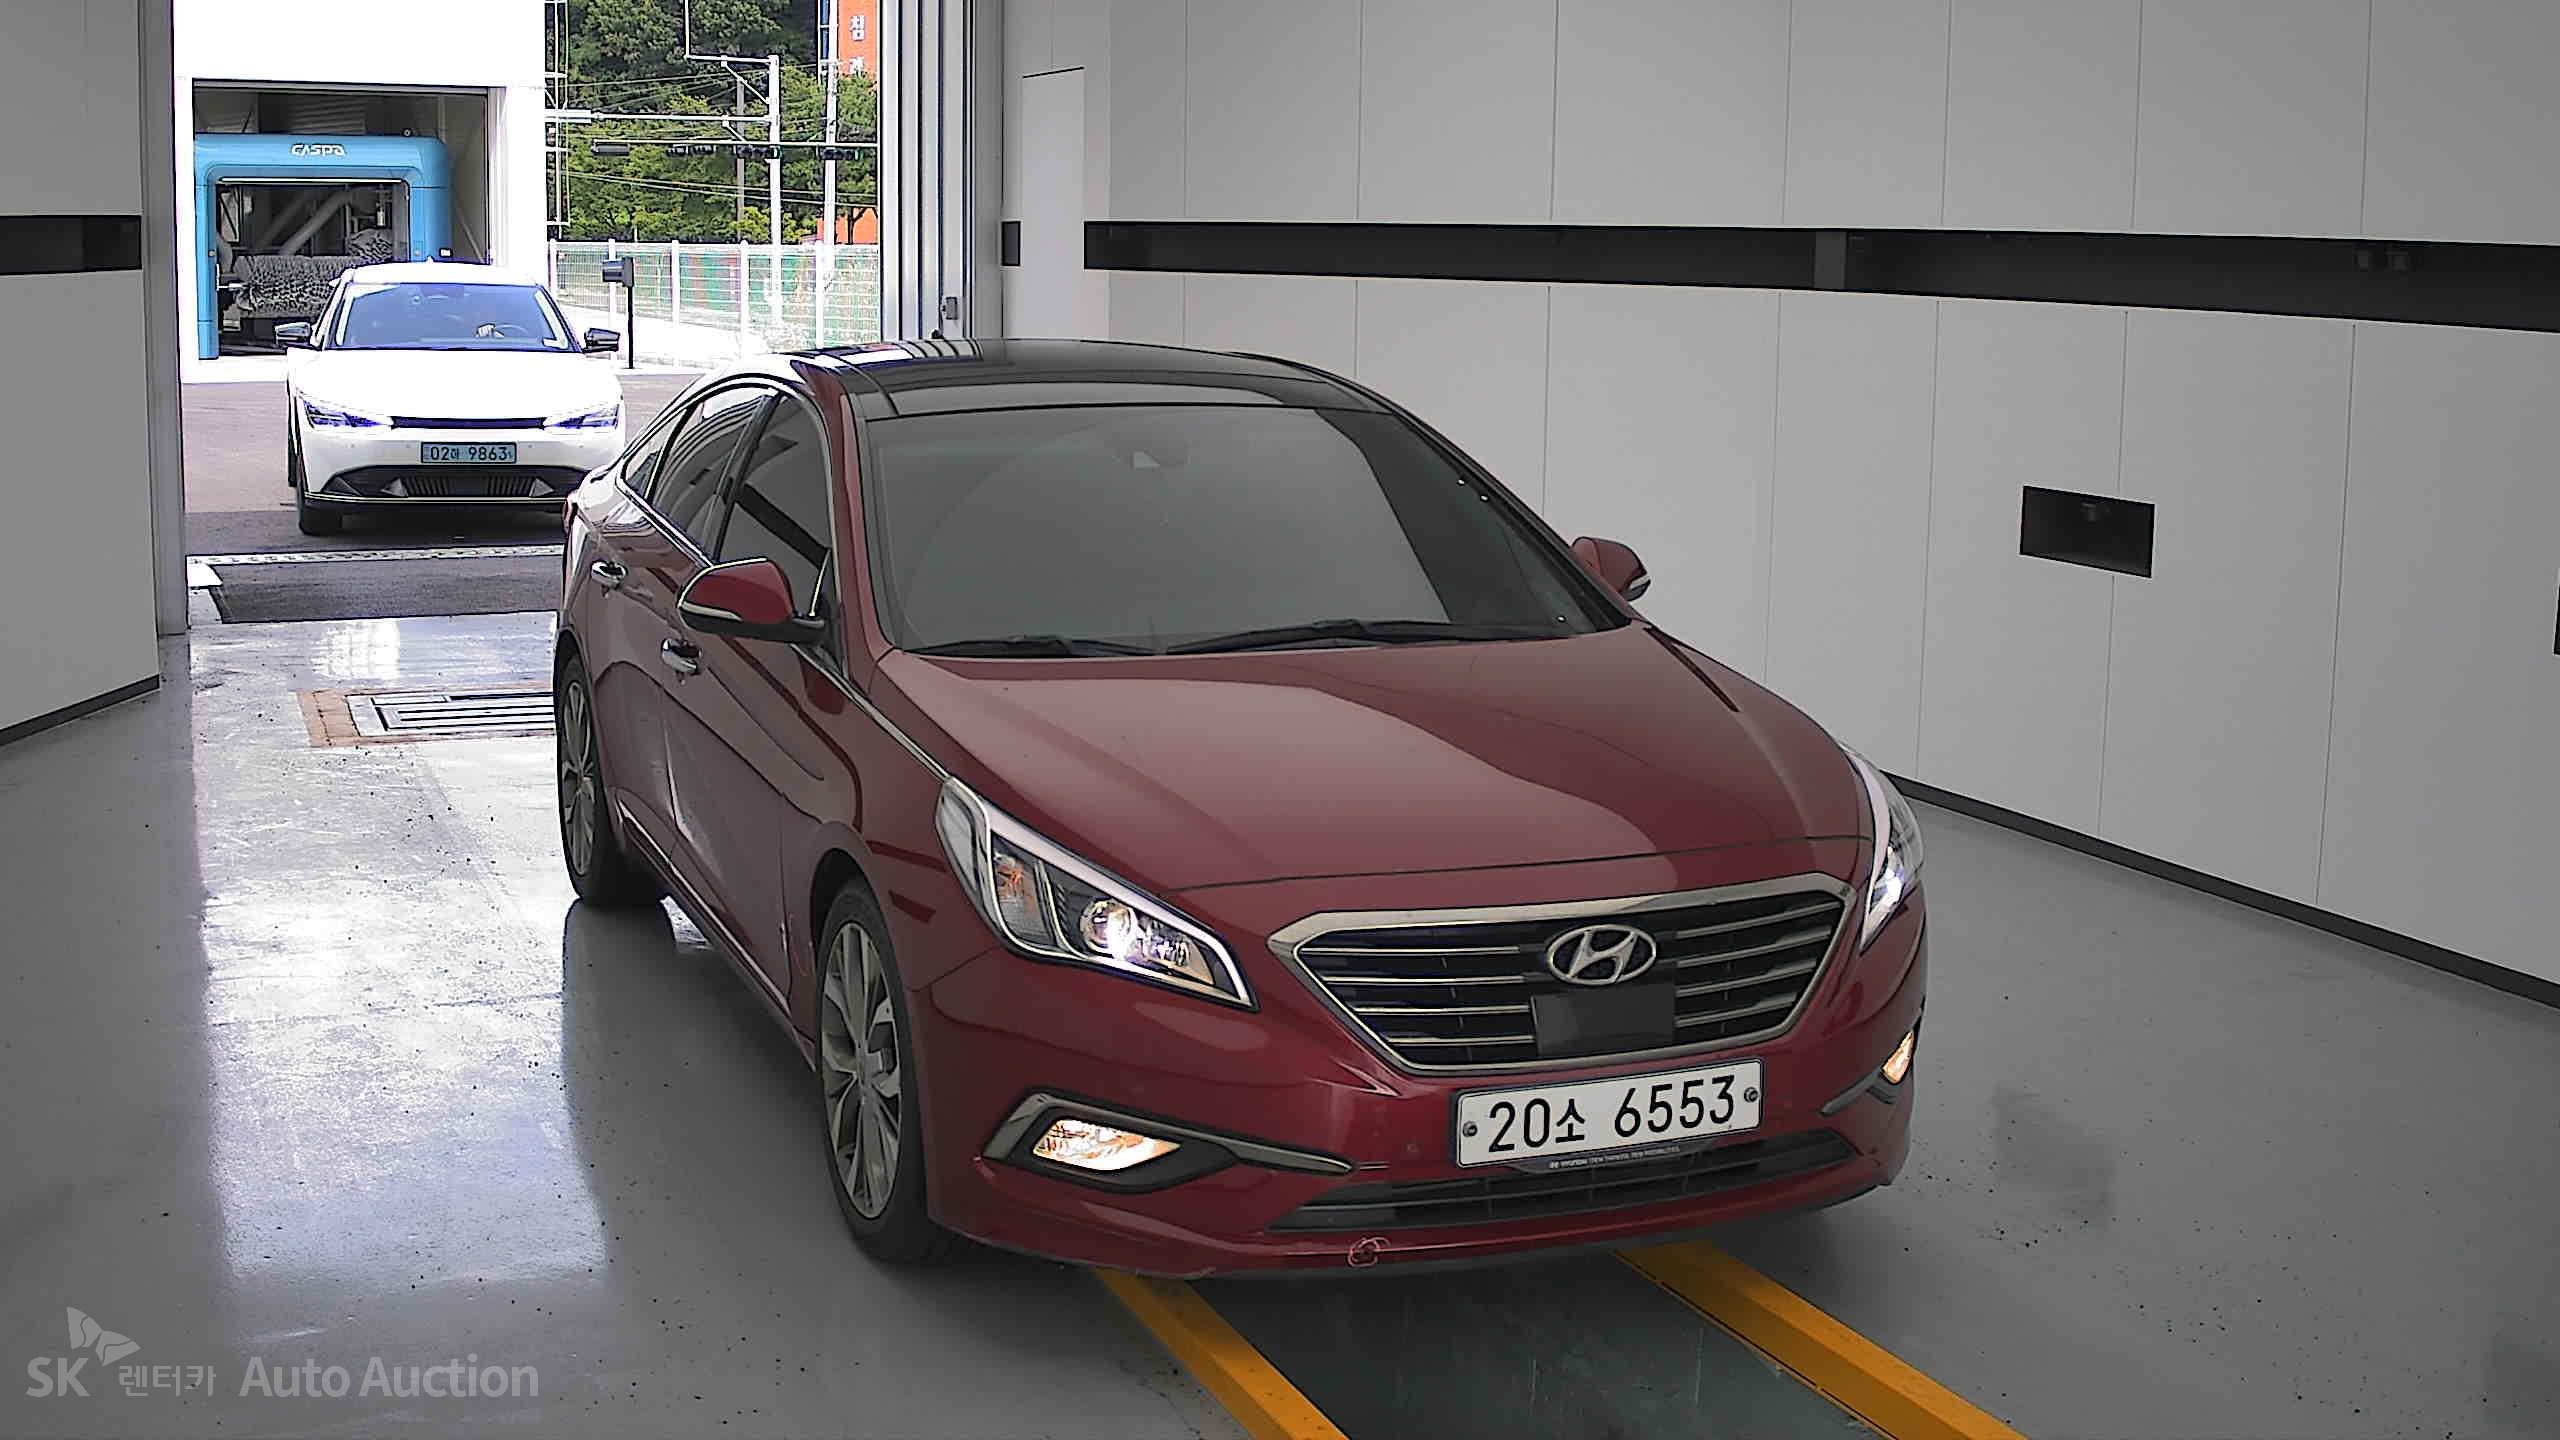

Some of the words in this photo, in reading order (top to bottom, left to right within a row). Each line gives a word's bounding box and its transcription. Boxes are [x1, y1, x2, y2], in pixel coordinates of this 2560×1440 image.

[468, 446, 508, 461] 9863
[1488, 1098, 1586, 1153] 20소
[1614, 1074, 1735, 1138] 6553
